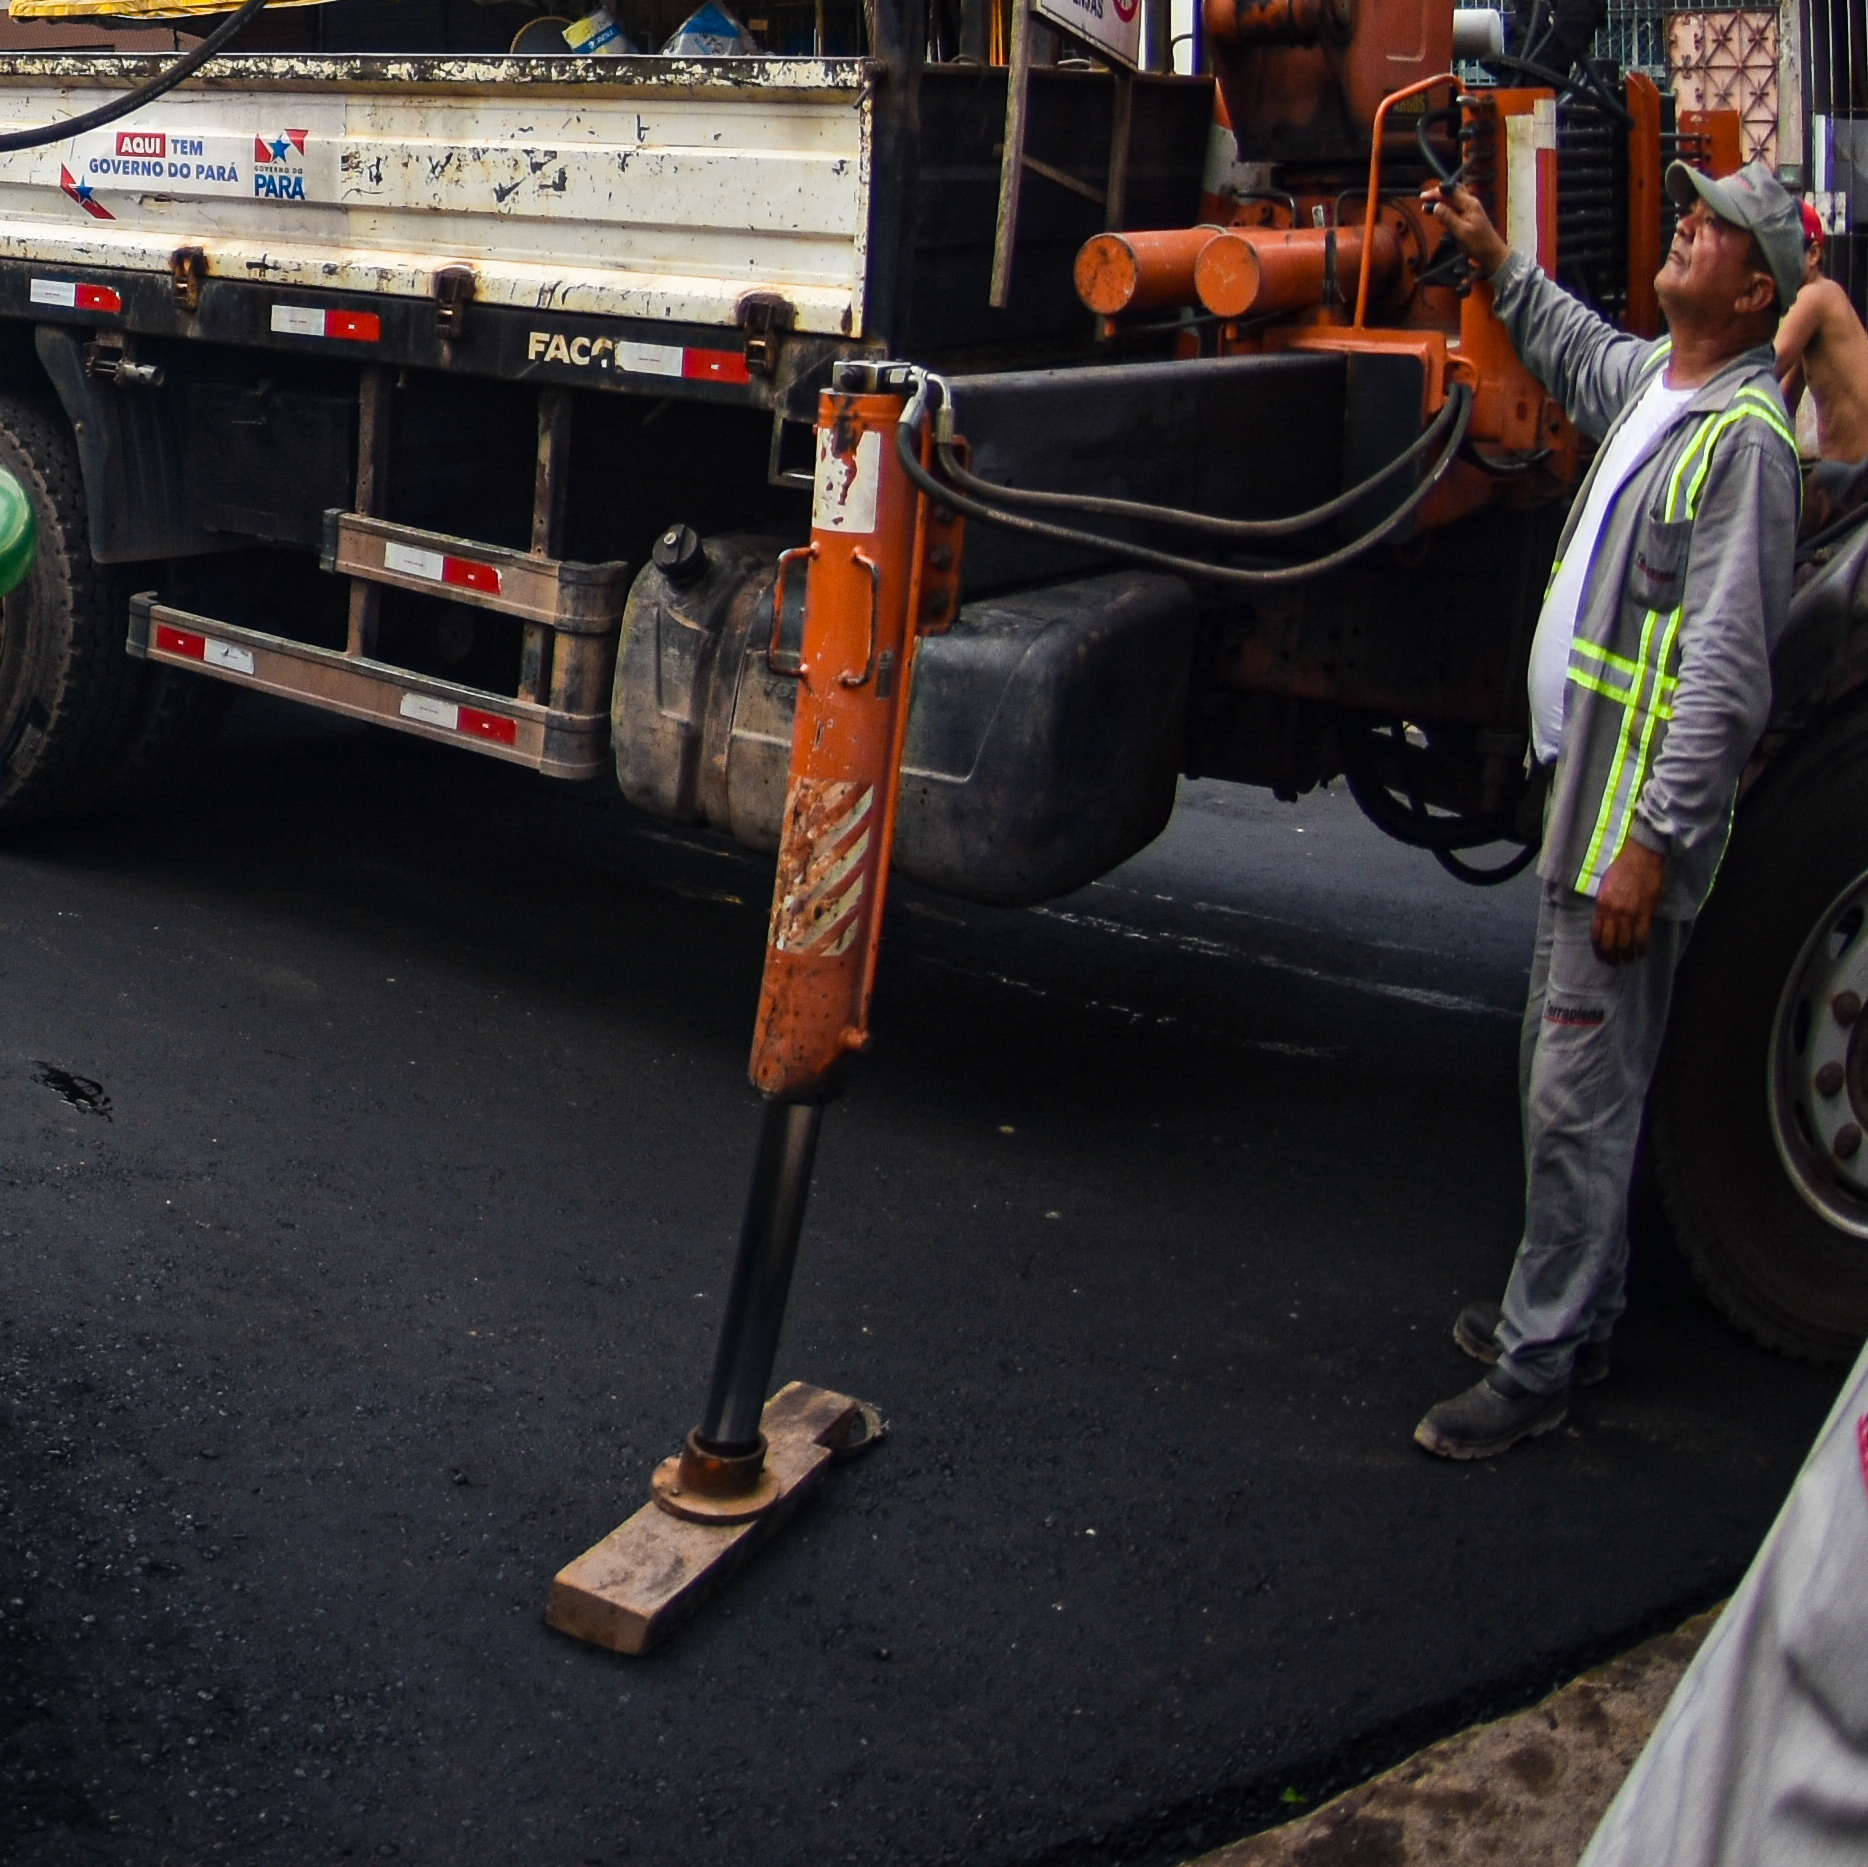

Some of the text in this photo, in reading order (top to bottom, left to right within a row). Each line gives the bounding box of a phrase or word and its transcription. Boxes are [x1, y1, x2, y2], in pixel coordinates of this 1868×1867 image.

[120, 136, 203, 157] AQUI TEM
[89, 158, 239, 183] GOVERNO DO PARÁ
[254, 165, 289, 174] GOVERNO
